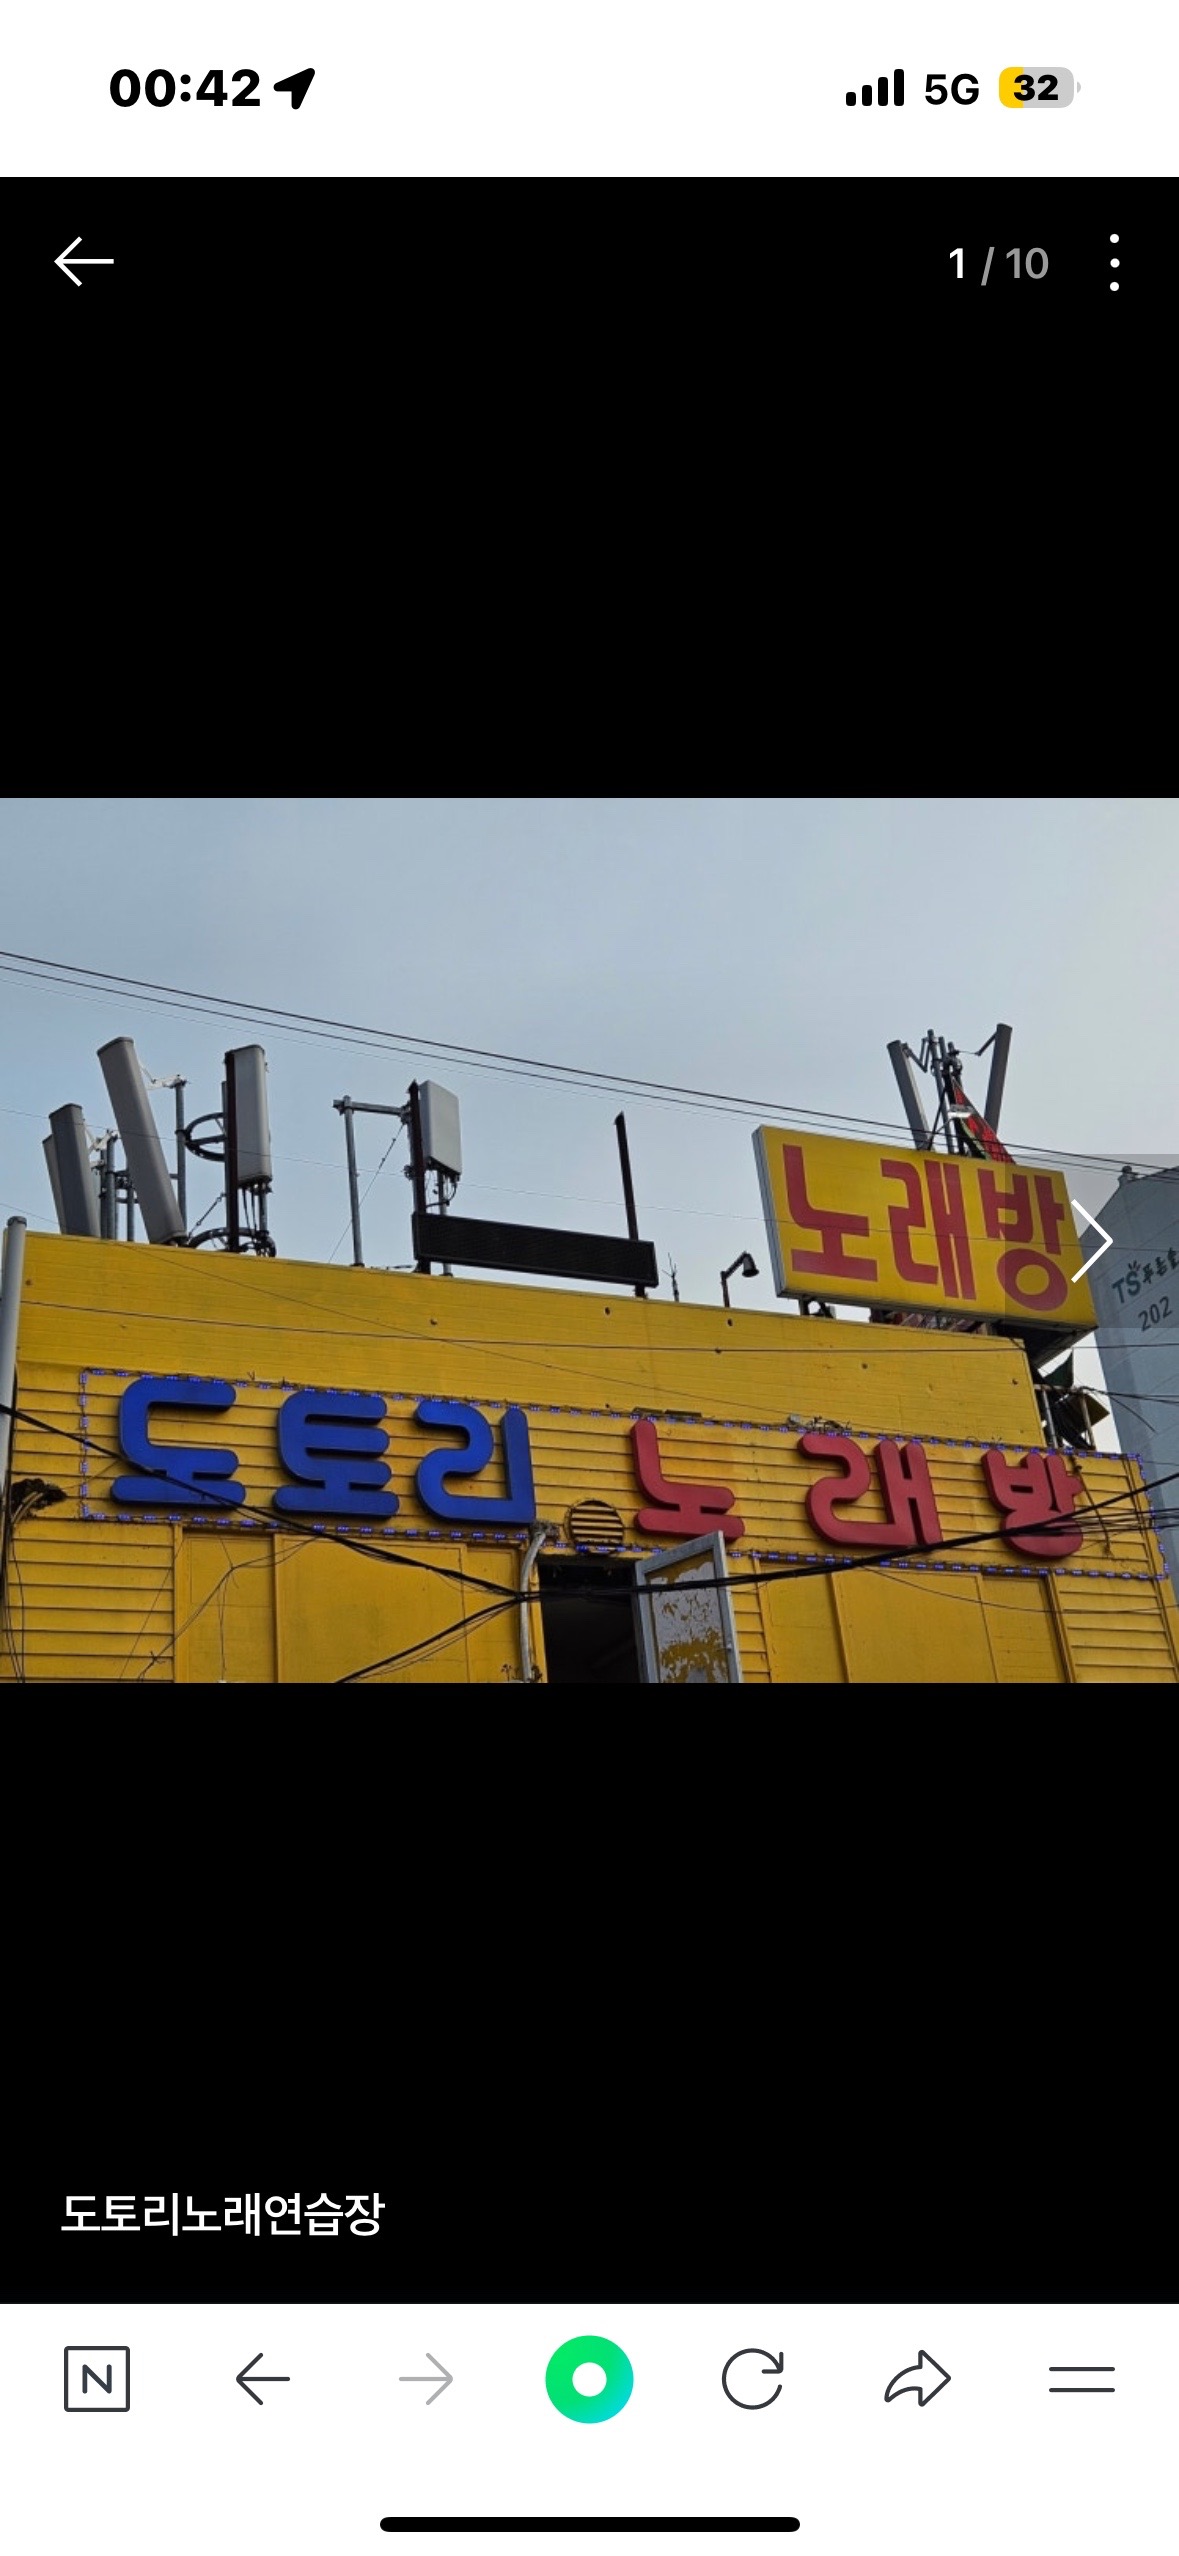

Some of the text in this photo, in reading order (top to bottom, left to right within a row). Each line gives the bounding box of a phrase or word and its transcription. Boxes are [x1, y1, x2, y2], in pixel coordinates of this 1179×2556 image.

[782, 1144, 1068, 1311] 노래방
[1138, 1296, 1173, 1332] 202
[111, 1377, 1084, 1559] 도토리 노래방
